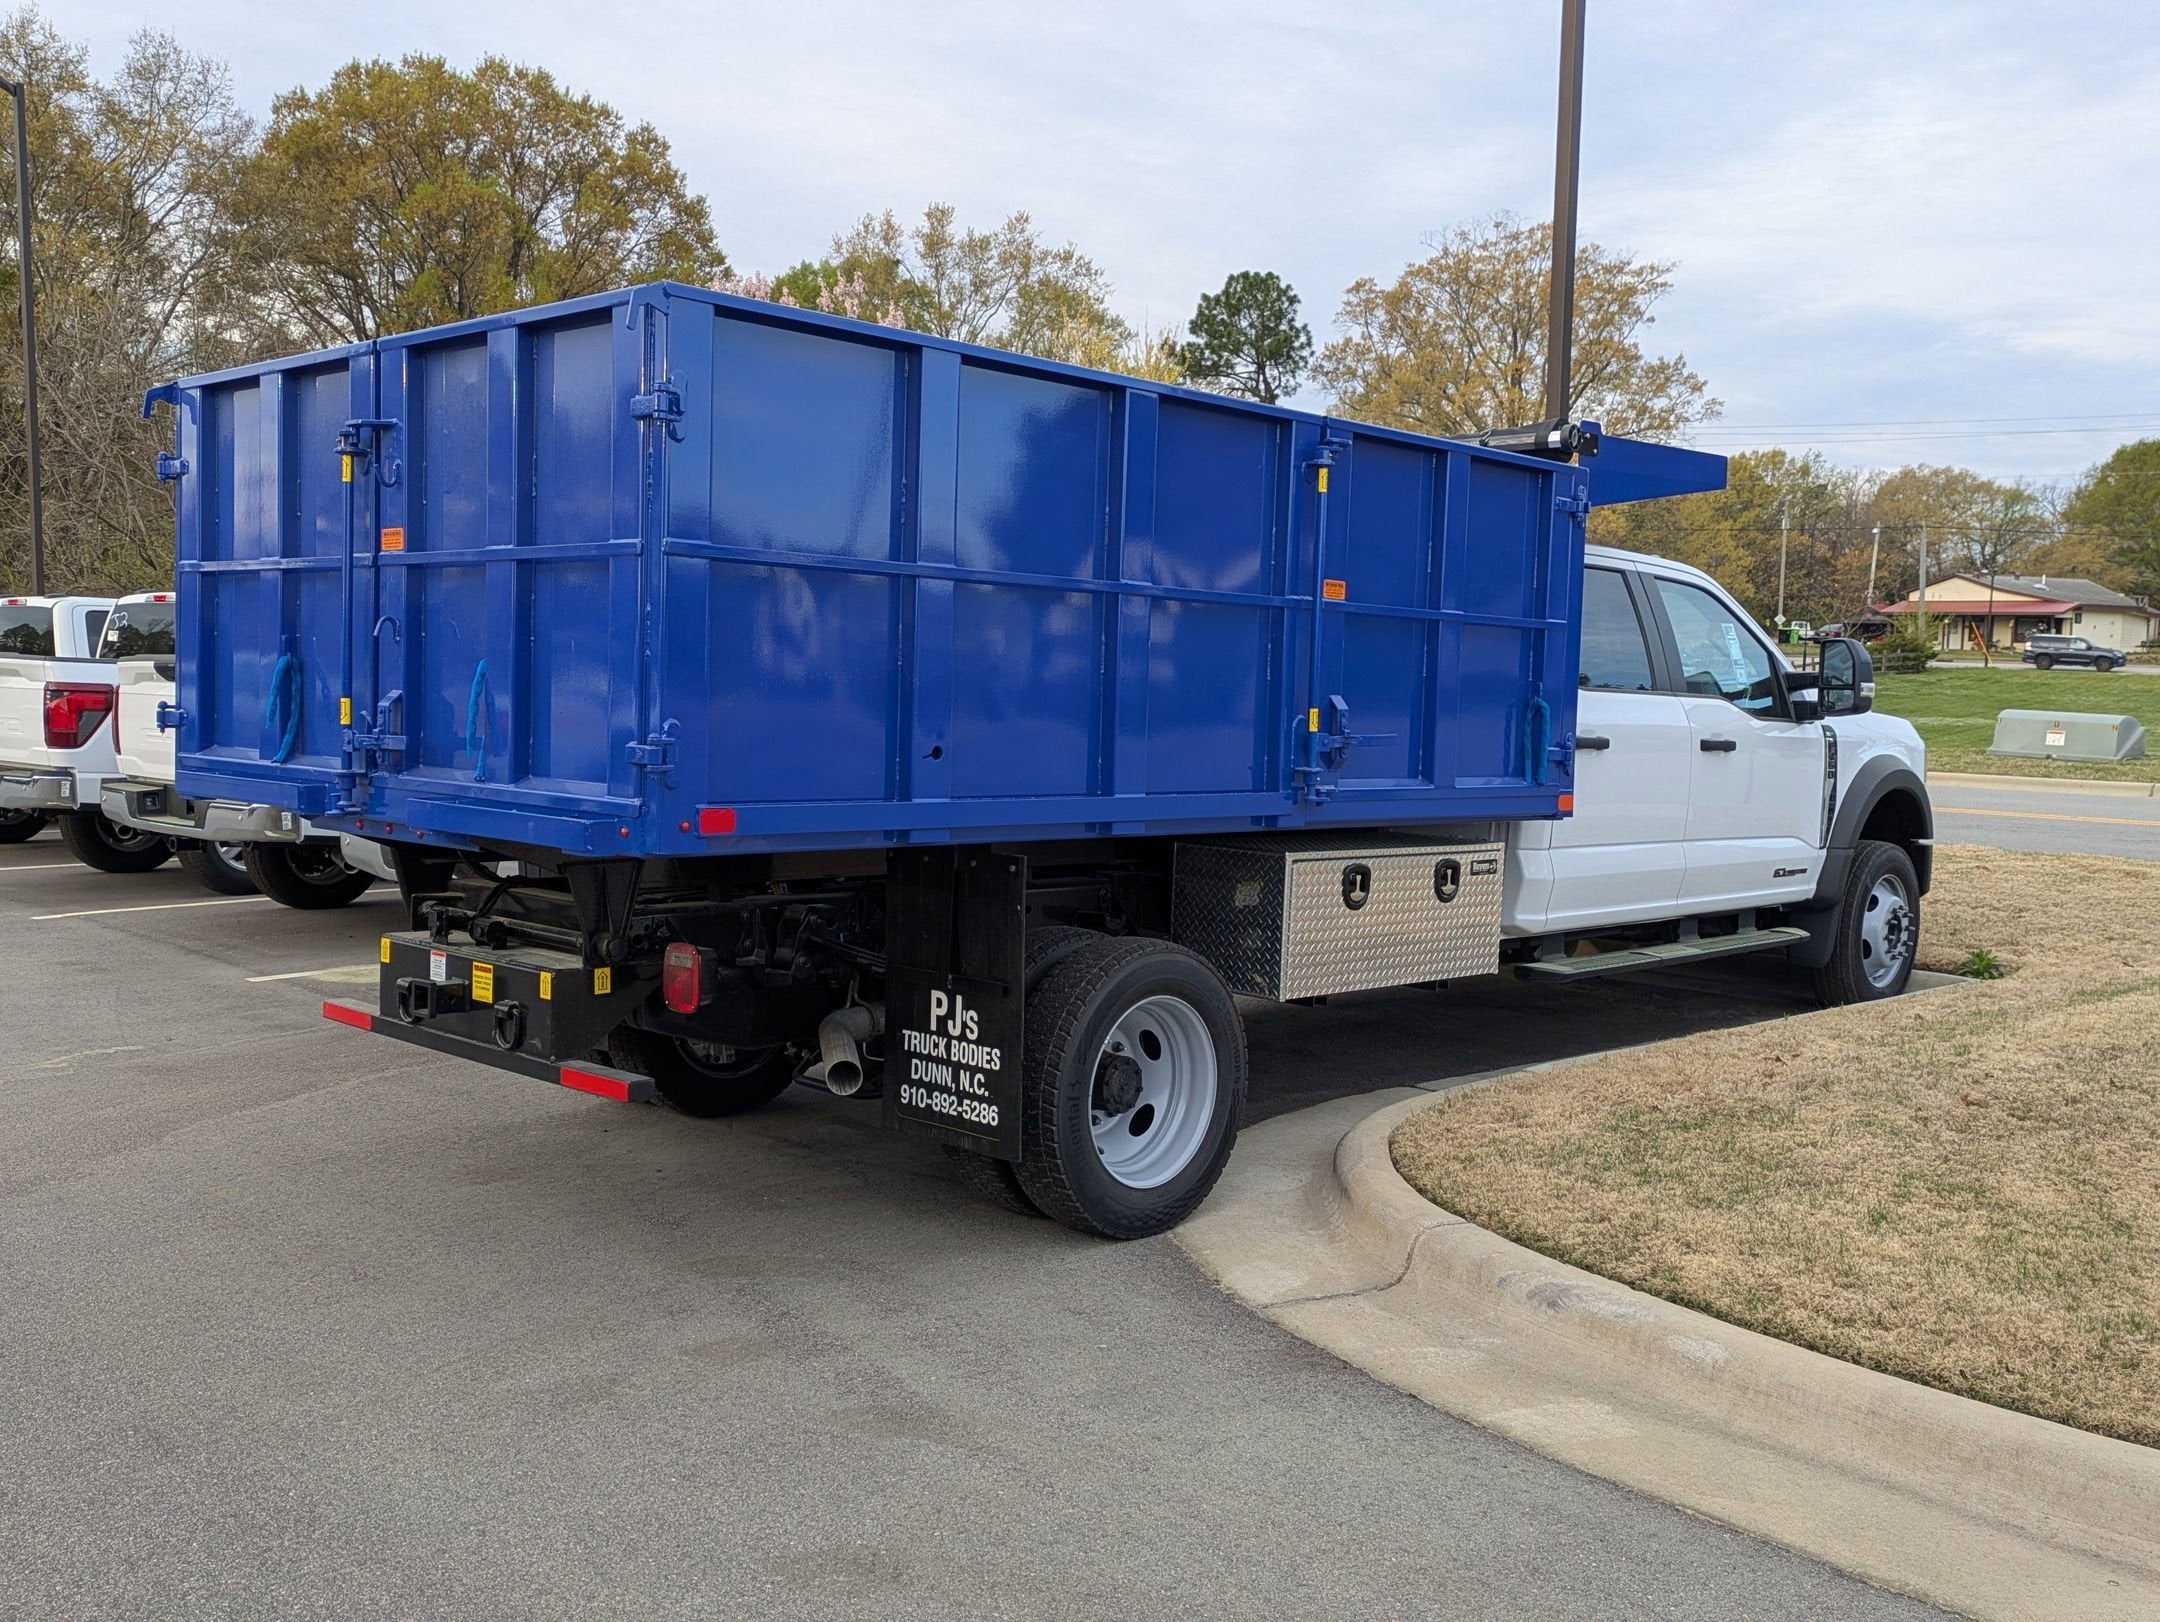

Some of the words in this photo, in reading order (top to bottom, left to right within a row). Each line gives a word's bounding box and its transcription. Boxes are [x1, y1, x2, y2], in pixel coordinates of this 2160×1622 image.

[902, 1029, 948, 1060] TRUCK
[950, 1039, 1001, 1071] BODIES
[911, 1058, 956, 1093] DUNN,
[959, 1069, 989, 1097] N.C.
[900, 1084, 999, 1126] 910-892-5286
